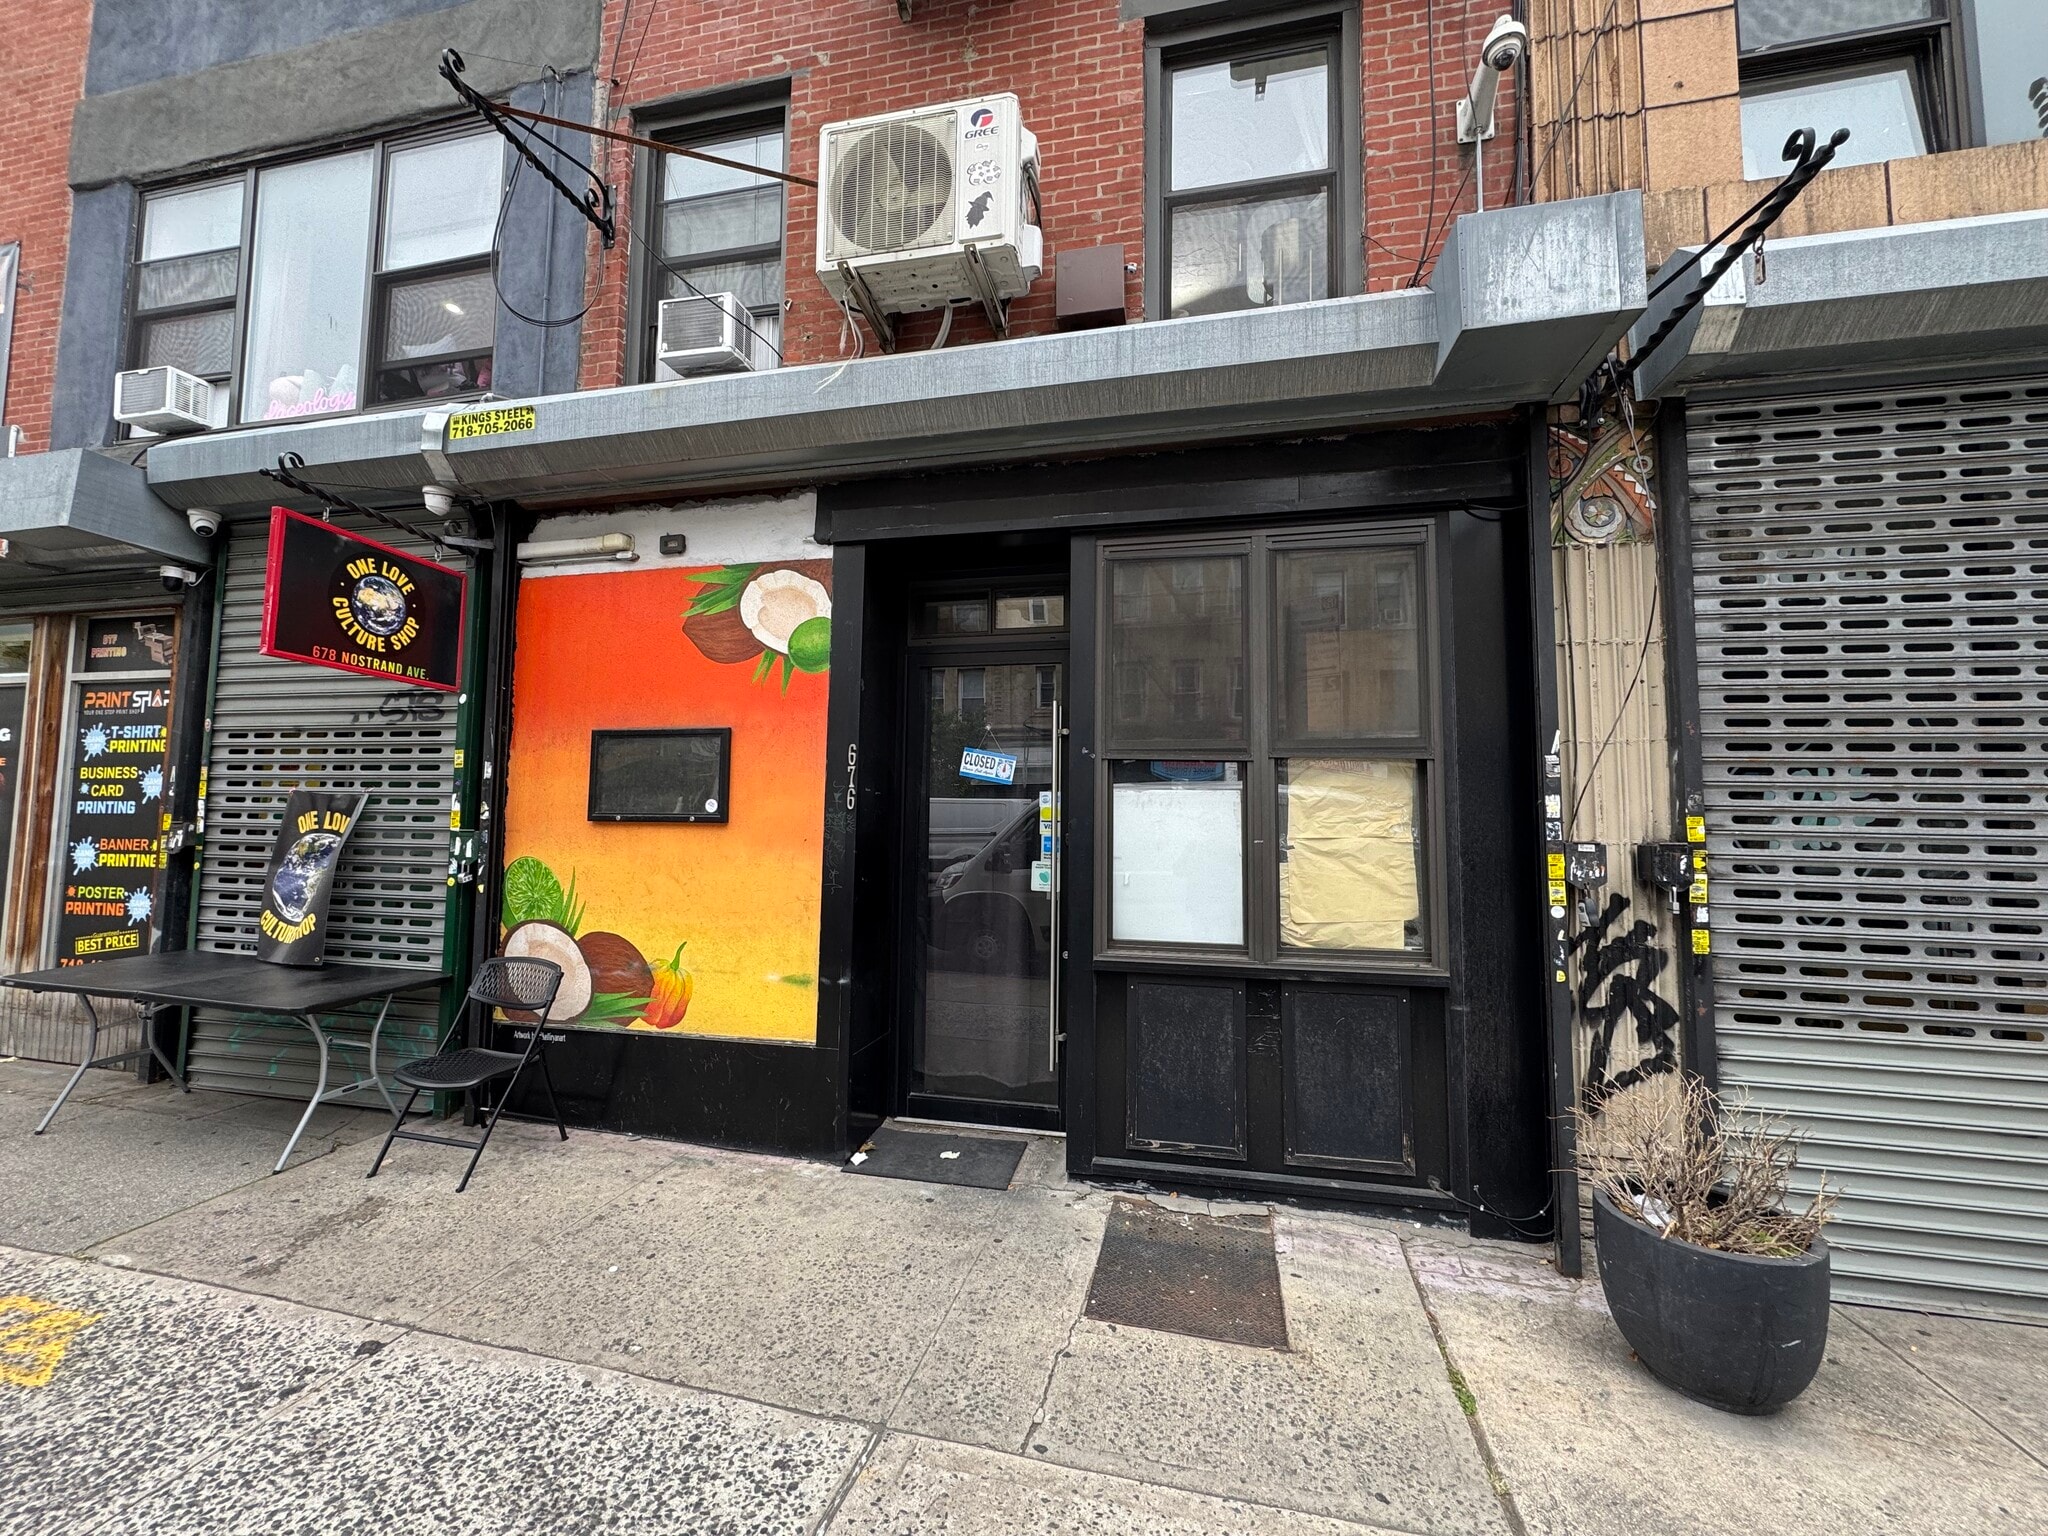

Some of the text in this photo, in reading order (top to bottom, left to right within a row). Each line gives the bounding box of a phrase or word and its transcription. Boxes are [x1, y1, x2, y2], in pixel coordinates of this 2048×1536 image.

[965, 126, 999, 139] GREE
[462, 412, 492, 425] KINGS
[494, 407, 525, 421] STEEL
[452, 418, 533, 438] 718-705-2066
[346, 558, 415, 595] ONE LOVE
[332, 597, 420, 652] CULTURE SHOP
[312, 645, 430, 680] 678 NOSTRAND AVE.
[111, 725, 161, 739] T-SHIRT
[964, 753, 996, 770] CLOSED
[79, 767, 138, 779] BUSINESS
[846, 744, 857, 810] 676
[91, 784, 124, 796] CARD
[76, 801, 136, 814] PRINTING
[297, 810, 319, 834] ONE
[100, 838, 149, 851] BANNER
[77, 886, 125, 899] POSTER
[65, 901, 125, 916] PRINTING
[78, 934, 137, 952] BEST PRICE
